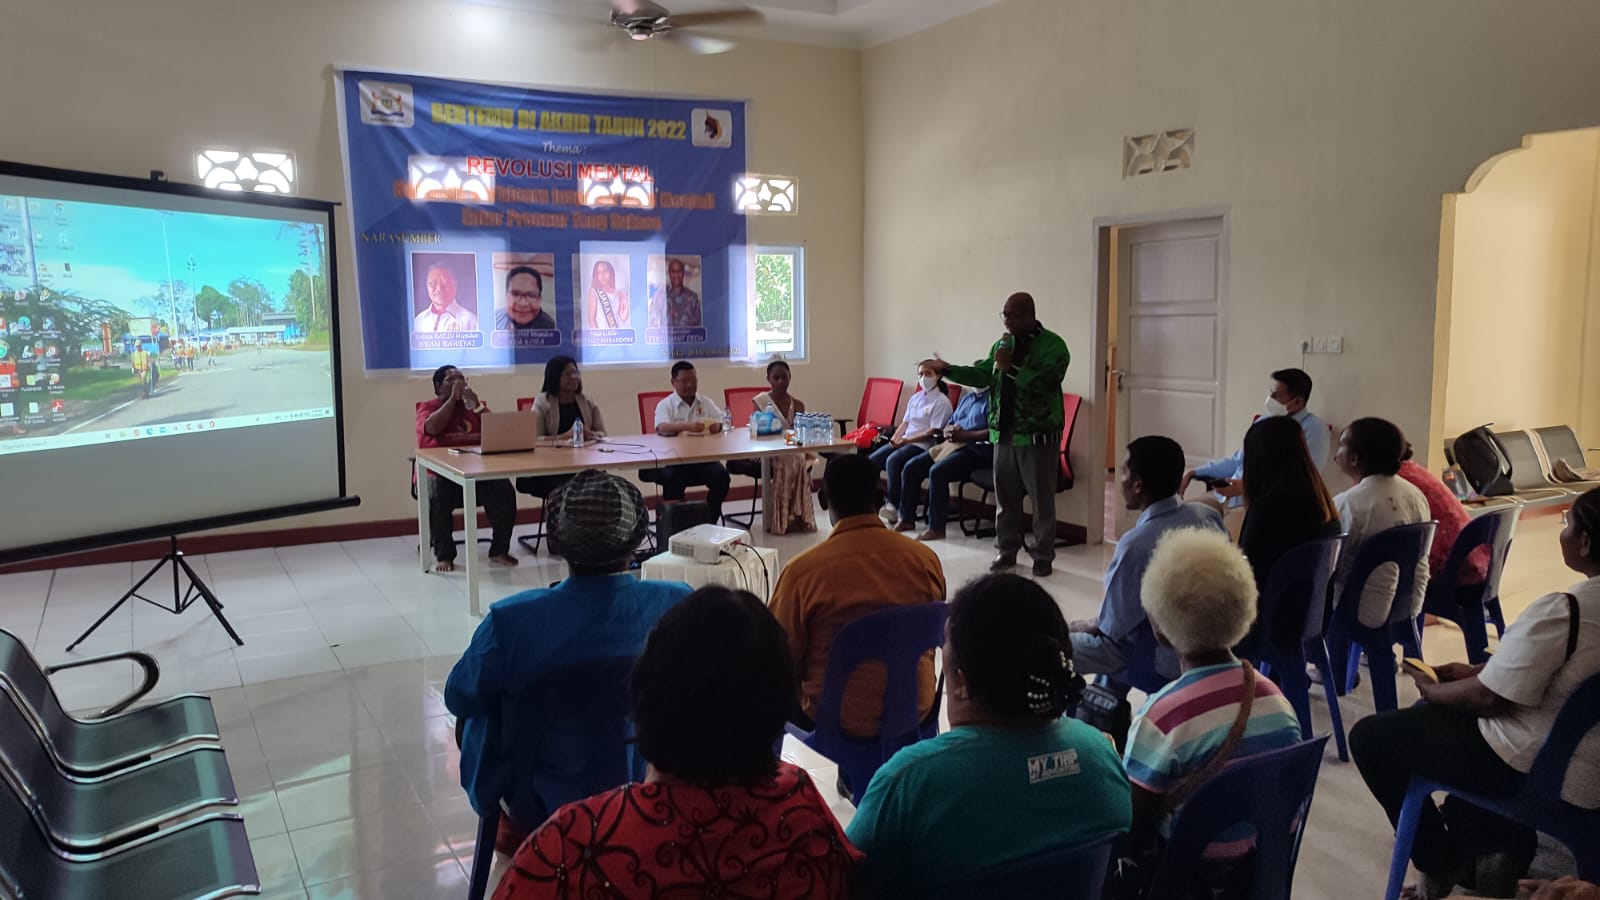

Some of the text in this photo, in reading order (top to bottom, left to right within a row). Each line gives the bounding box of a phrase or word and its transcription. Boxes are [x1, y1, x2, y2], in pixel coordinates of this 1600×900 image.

[431, 102, 687, 139] BERTEMU DI AKHIR TAHUN 2022
[466, 155, 655, 184] REVOLUSI MENTAL
[361, 231, 441, 245] NARASUMBER
